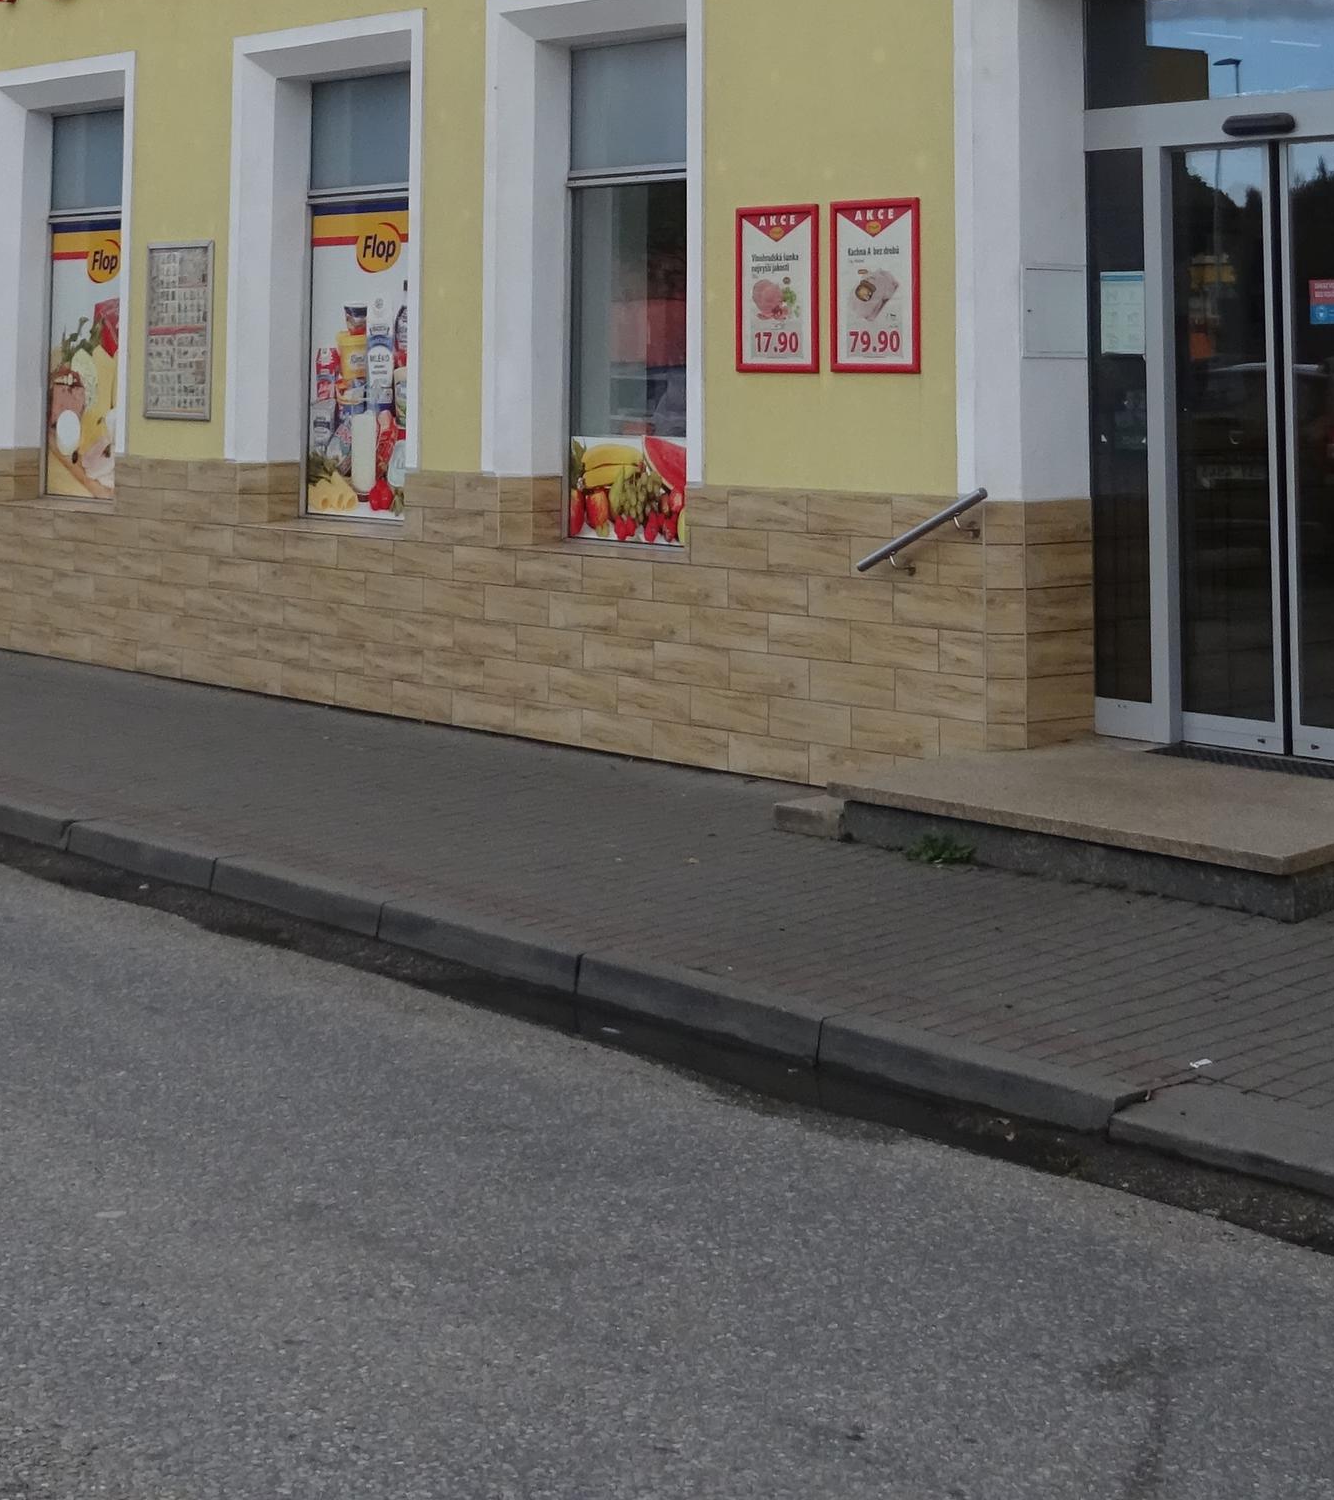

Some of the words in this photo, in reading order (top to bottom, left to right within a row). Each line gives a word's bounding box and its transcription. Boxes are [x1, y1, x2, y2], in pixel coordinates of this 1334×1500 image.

[758, 214, 795, 227] AKCE
[855, 209, 894, 221] AKCE
[363, 234, 396, 262] Flop
[92, 249, 118, 274] Flop
[755, 332, 799, 353] 17.90
[849, 330, 900, 353] 79.90
